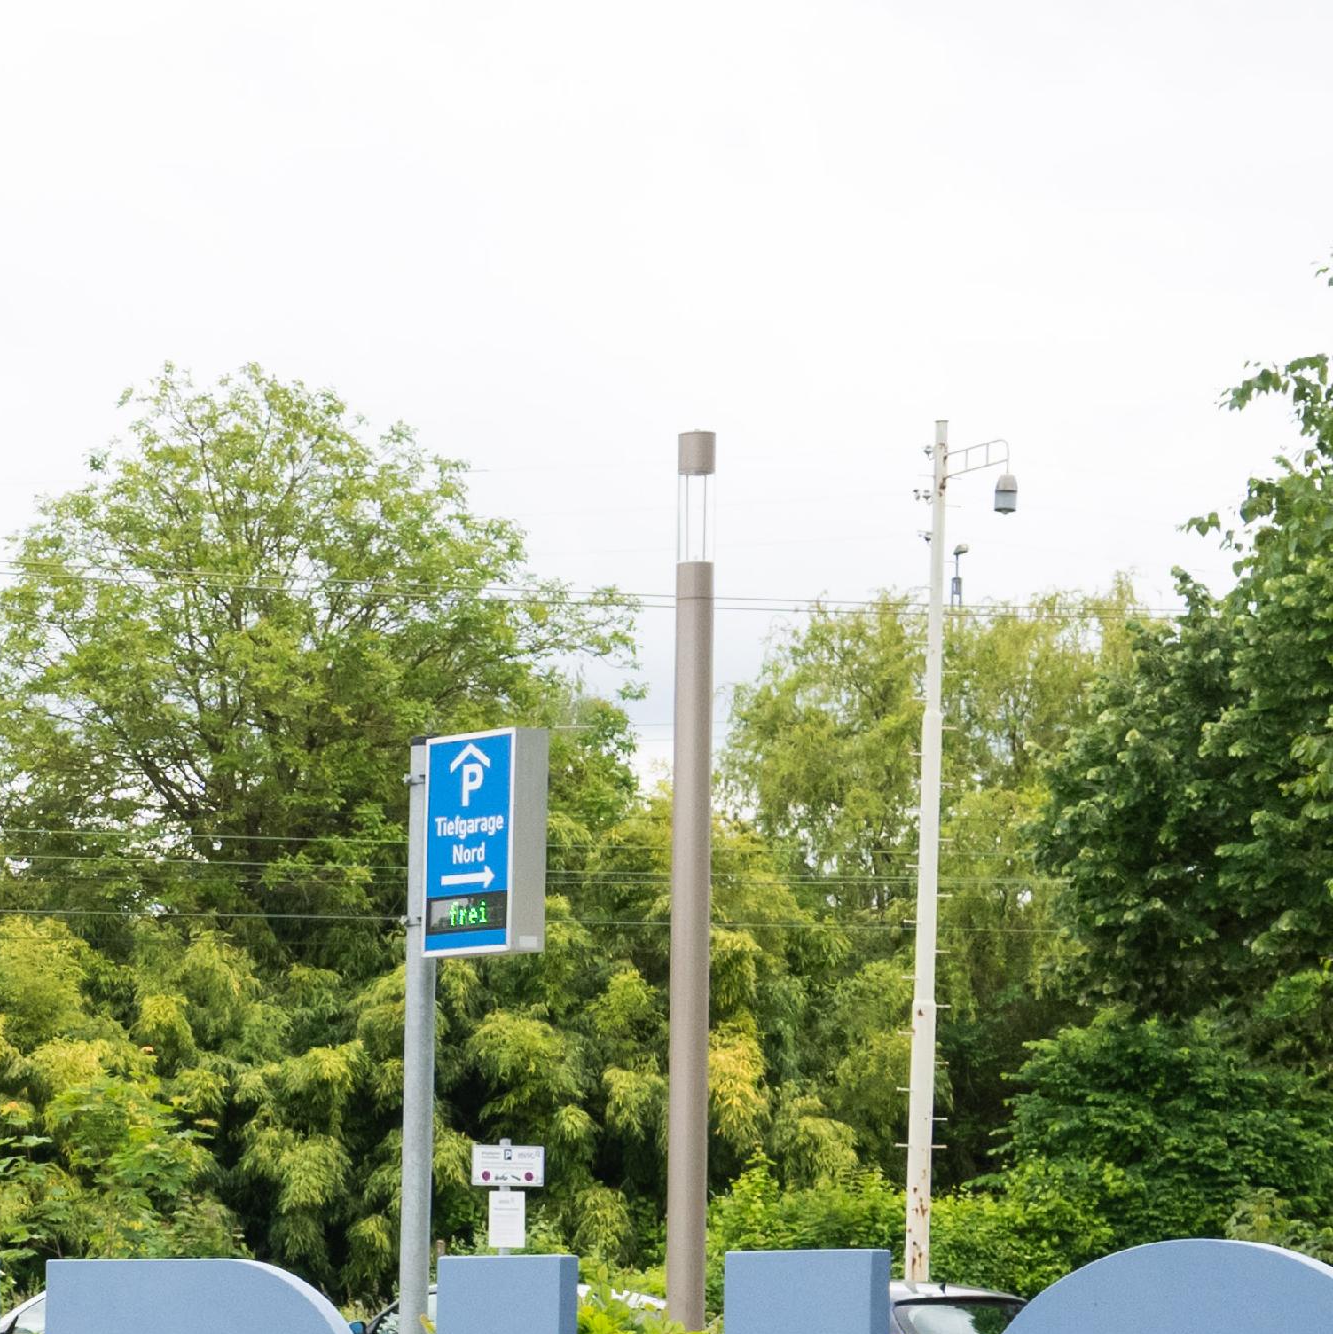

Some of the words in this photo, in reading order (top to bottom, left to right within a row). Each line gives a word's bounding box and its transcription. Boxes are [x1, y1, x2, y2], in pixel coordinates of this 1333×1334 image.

[461, 763, 483, 807] P
[435, 814, 504, 840] Tiefgarage
[452, 842, 485, 865] Nord
[449, 901, 488, 926] frei
